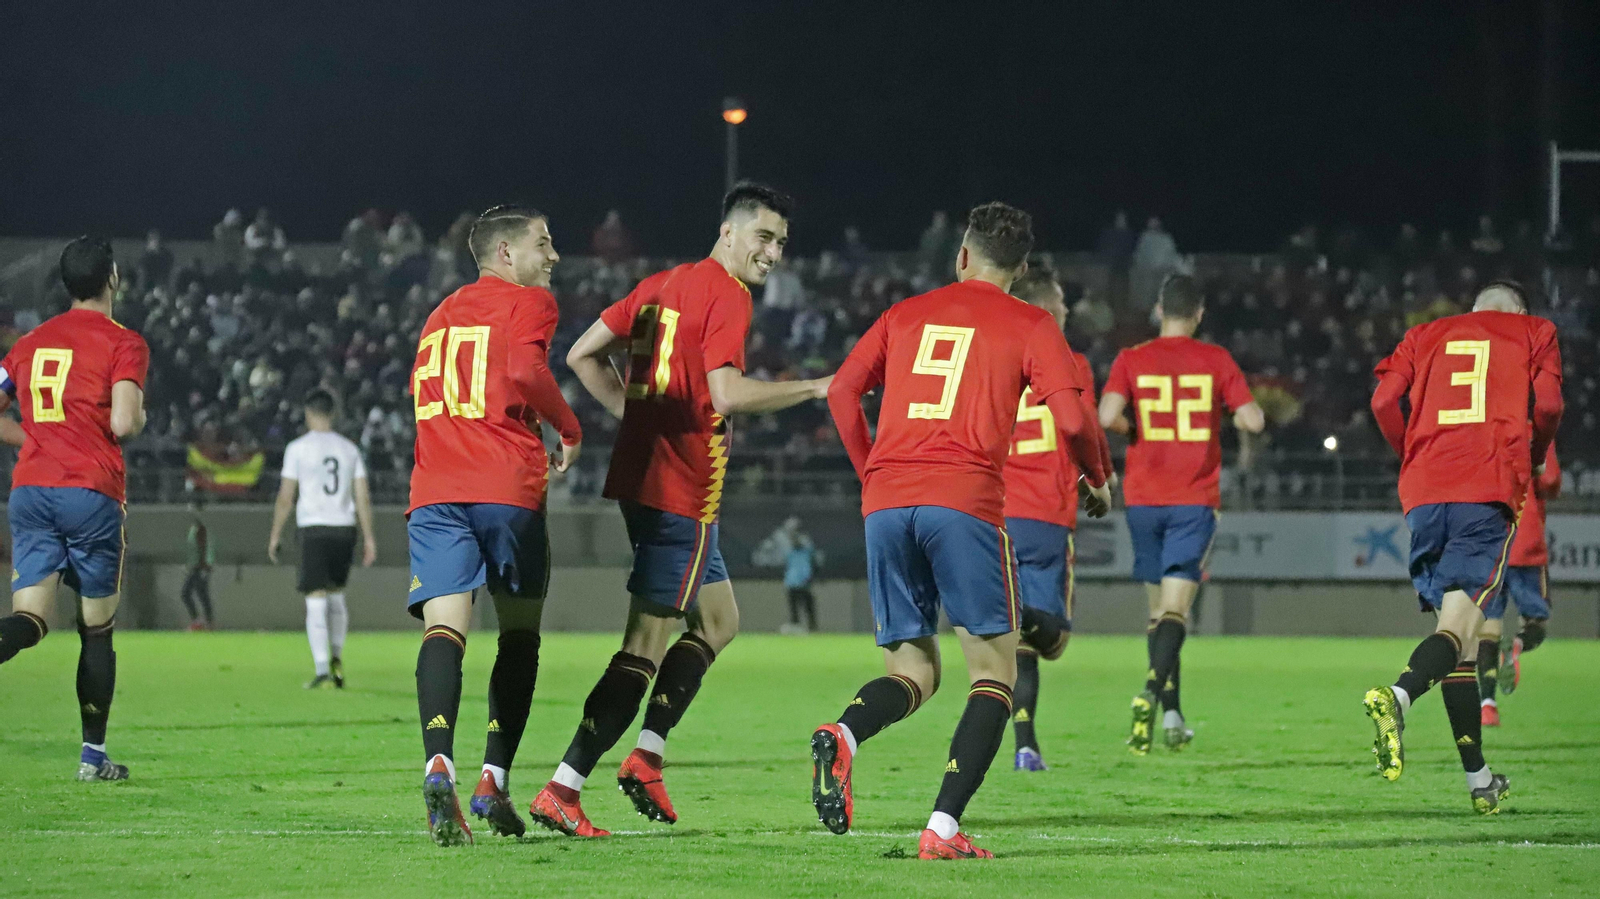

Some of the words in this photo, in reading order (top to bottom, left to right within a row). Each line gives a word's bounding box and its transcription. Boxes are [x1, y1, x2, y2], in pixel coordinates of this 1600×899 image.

[30, 348, 73, 423] 8
[413, 326, 491, 423] 20
[625, 305, 681, 399] 21
[907, 324, 976, 420] 9
[1438, 340, 1490, 424] 3
[1008, 385, 1057, 455] 5
[1137, 375, 1212, 441] 22
[322, 456, 339, 496] 3
